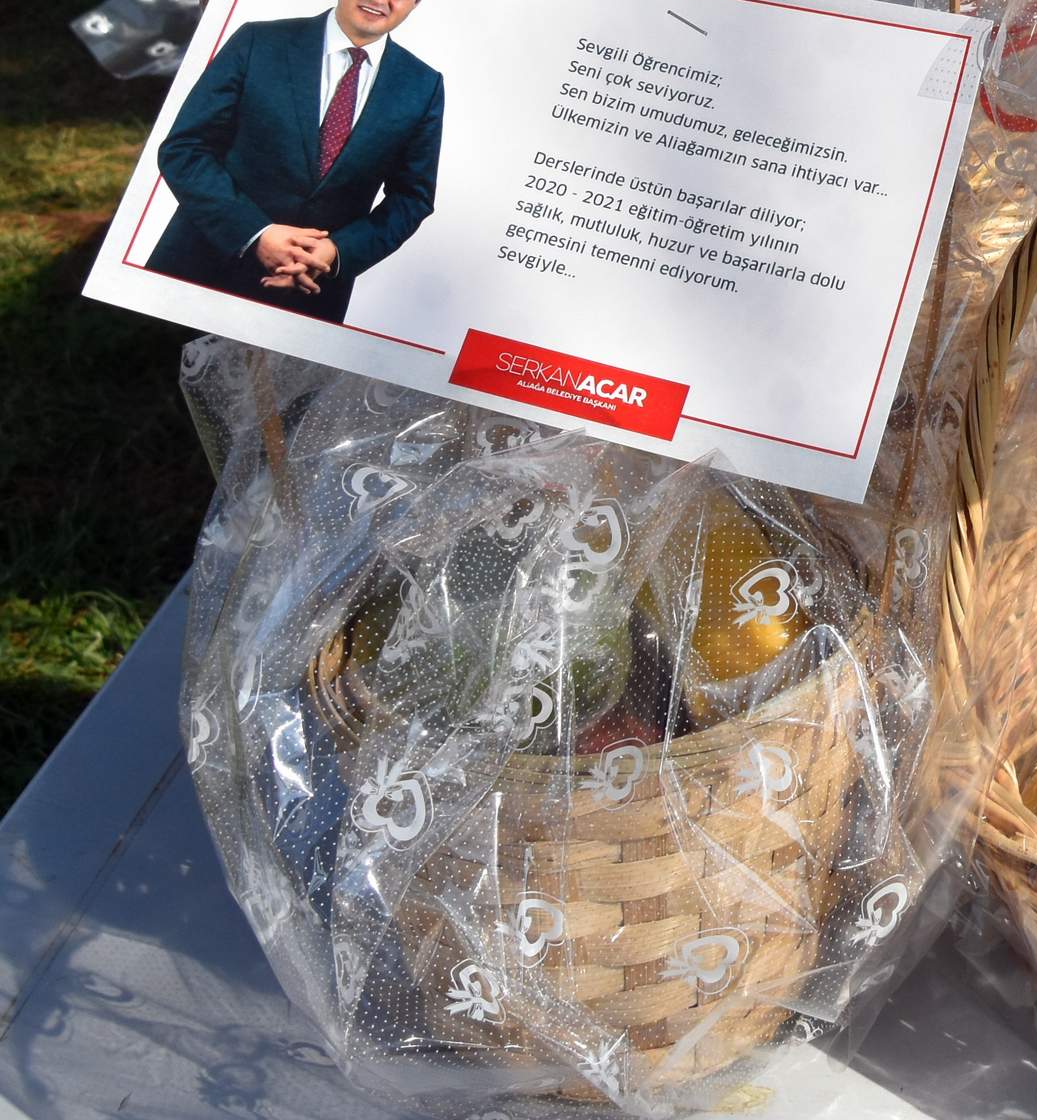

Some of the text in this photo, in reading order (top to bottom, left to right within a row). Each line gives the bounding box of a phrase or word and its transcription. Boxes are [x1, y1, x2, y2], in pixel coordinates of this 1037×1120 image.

[566, 59, 716, 111] Seni çok seviyoruz.
[575, 36, 724, 89] Sevgili Öğrencimiz;
[550, 102, 889, 198] Ülkemizin ve Aliağamızın sana ihtiyacı var...
[558, 81, 849, 164] Sen bizim umudumuz, geleceğimizsin.
[523, 173, 569, 198] 2020
[580, 189, 624, 214] 2021
[627, 202, 746, 244] eğitim-öğretim
[747, 232, 801, 256] yılının
[532, 150, 807, 234] Derslerinde üstün başarılar diliyor;
[496, 244, 577, 280] Sevgiyle...
[504, 222, 739, 294] geçmesini temenni ediyorum.
[514, 199, 847, 292] sağlık, mutluluk, huzur ve başarılarla dolu
